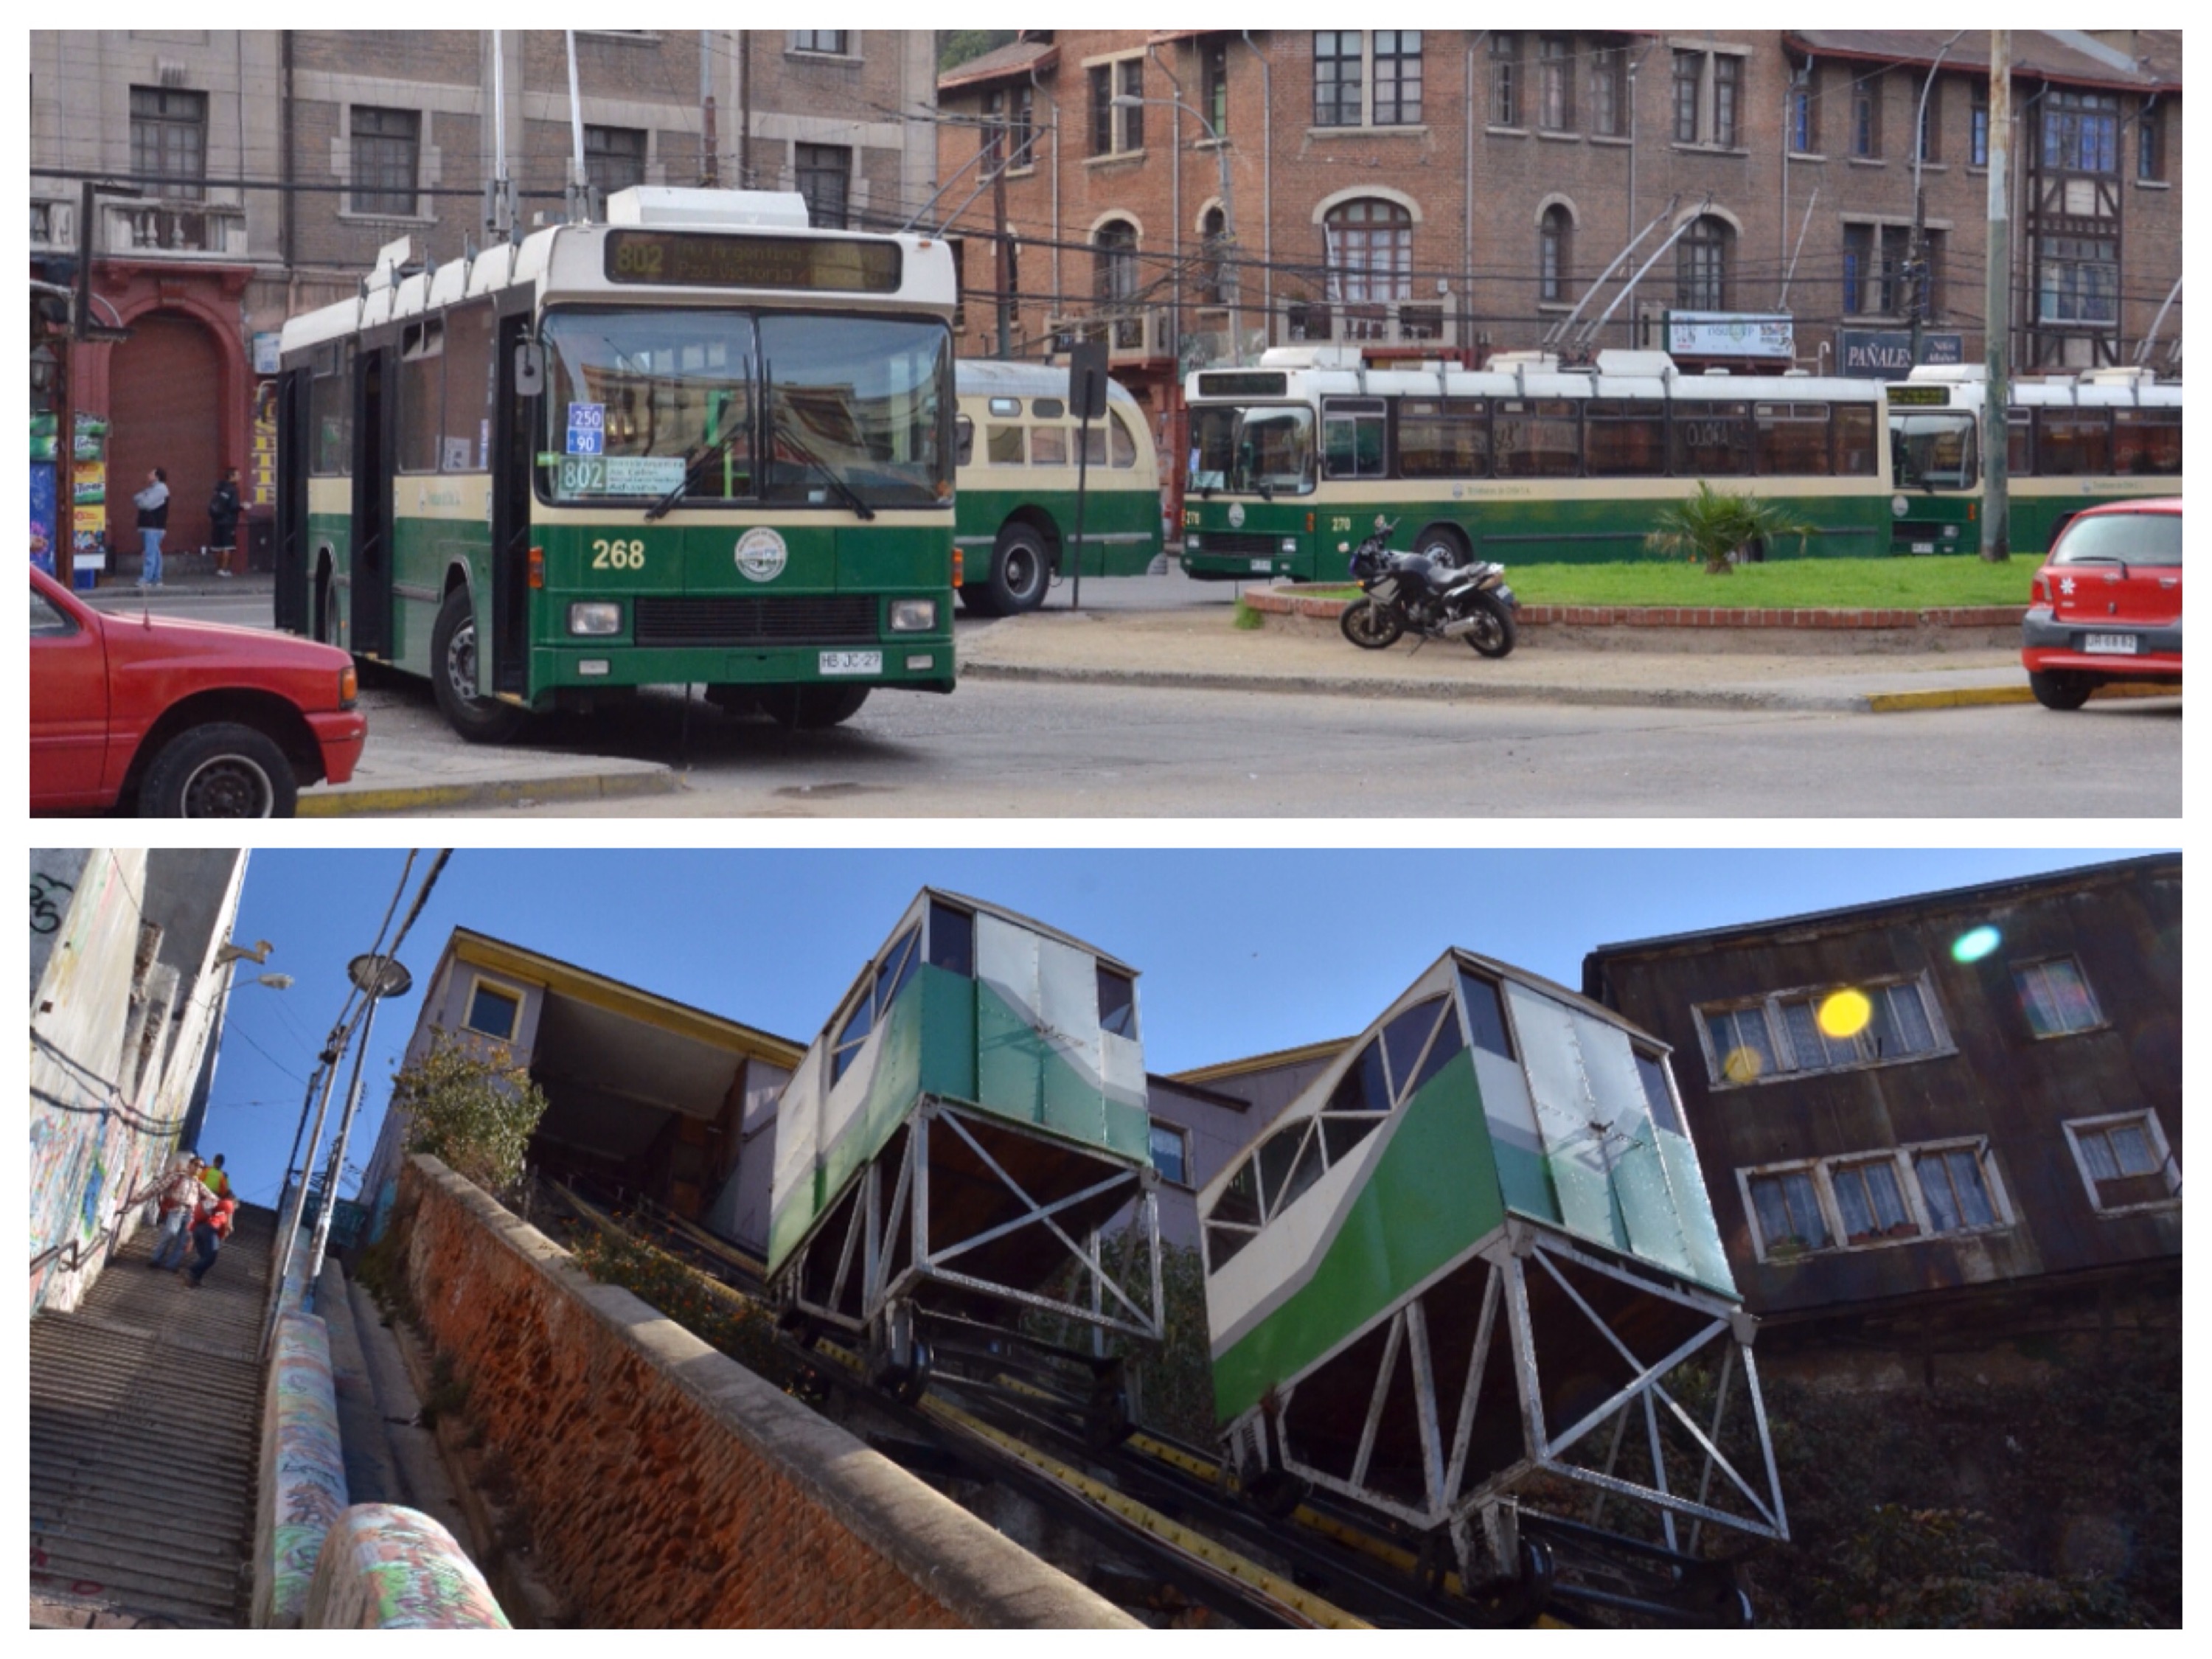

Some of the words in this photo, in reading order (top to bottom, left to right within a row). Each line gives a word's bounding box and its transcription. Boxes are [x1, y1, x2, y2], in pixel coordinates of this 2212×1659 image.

[616, 245, 662, 274] 802
[575, 411, 601, 427] 250
[577, 436, 595, 452] 90
[566, 462, 602, 488] 802
[592, 539, 646, 570] 268
